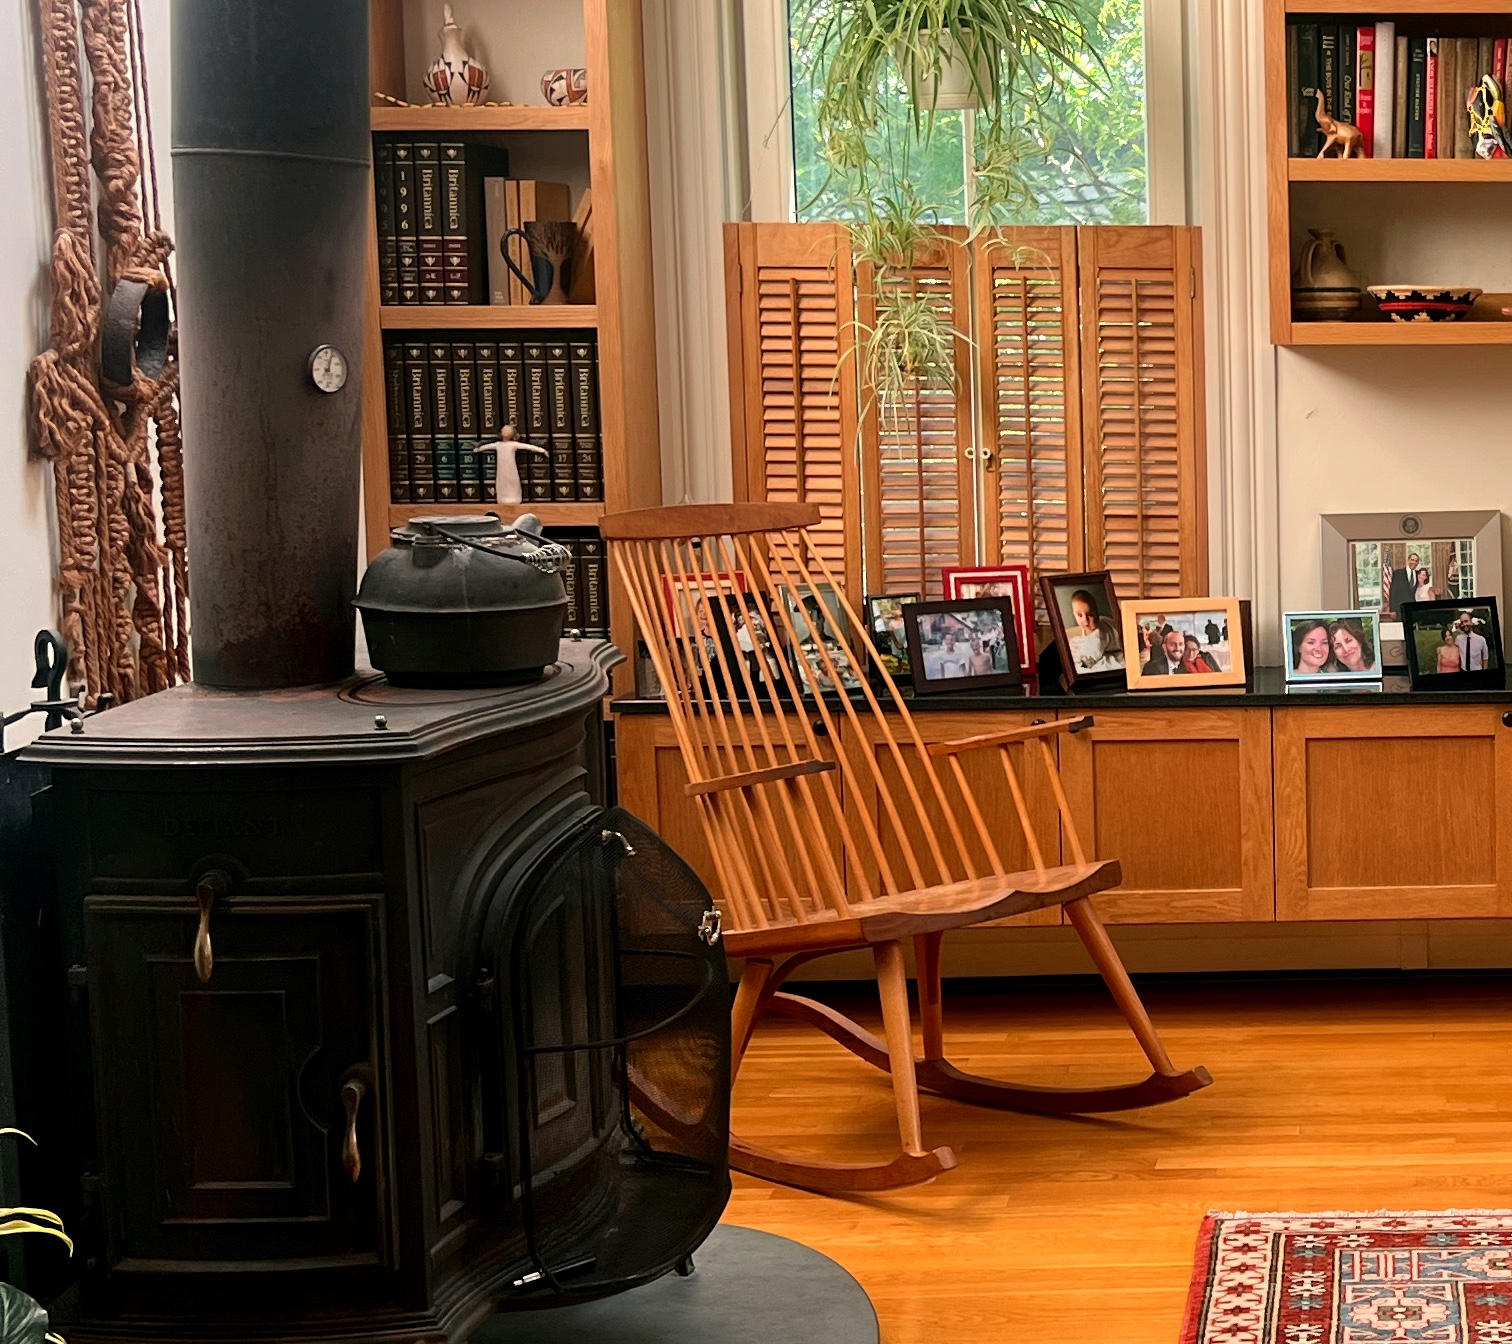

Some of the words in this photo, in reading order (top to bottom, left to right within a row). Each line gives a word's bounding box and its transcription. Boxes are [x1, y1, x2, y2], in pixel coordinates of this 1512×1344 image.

[399, 170, 410, 231] 1996
[421, 169, 434, 230] Britannica
[448, 169, 461, 230] Britannica
[411, 368, 425, 429] Britannica
[436, 368, 449, 429] Britannica
[459, 368, 473, 429] Britannica
[482, 368, 496, 429] Britannica
[530, 368, 543, 429] Britannica
[553, 368, 567, 429] Britannica
[577, 368, 590, 429] Britannica
[588, 563, 600, 622] Britannica
